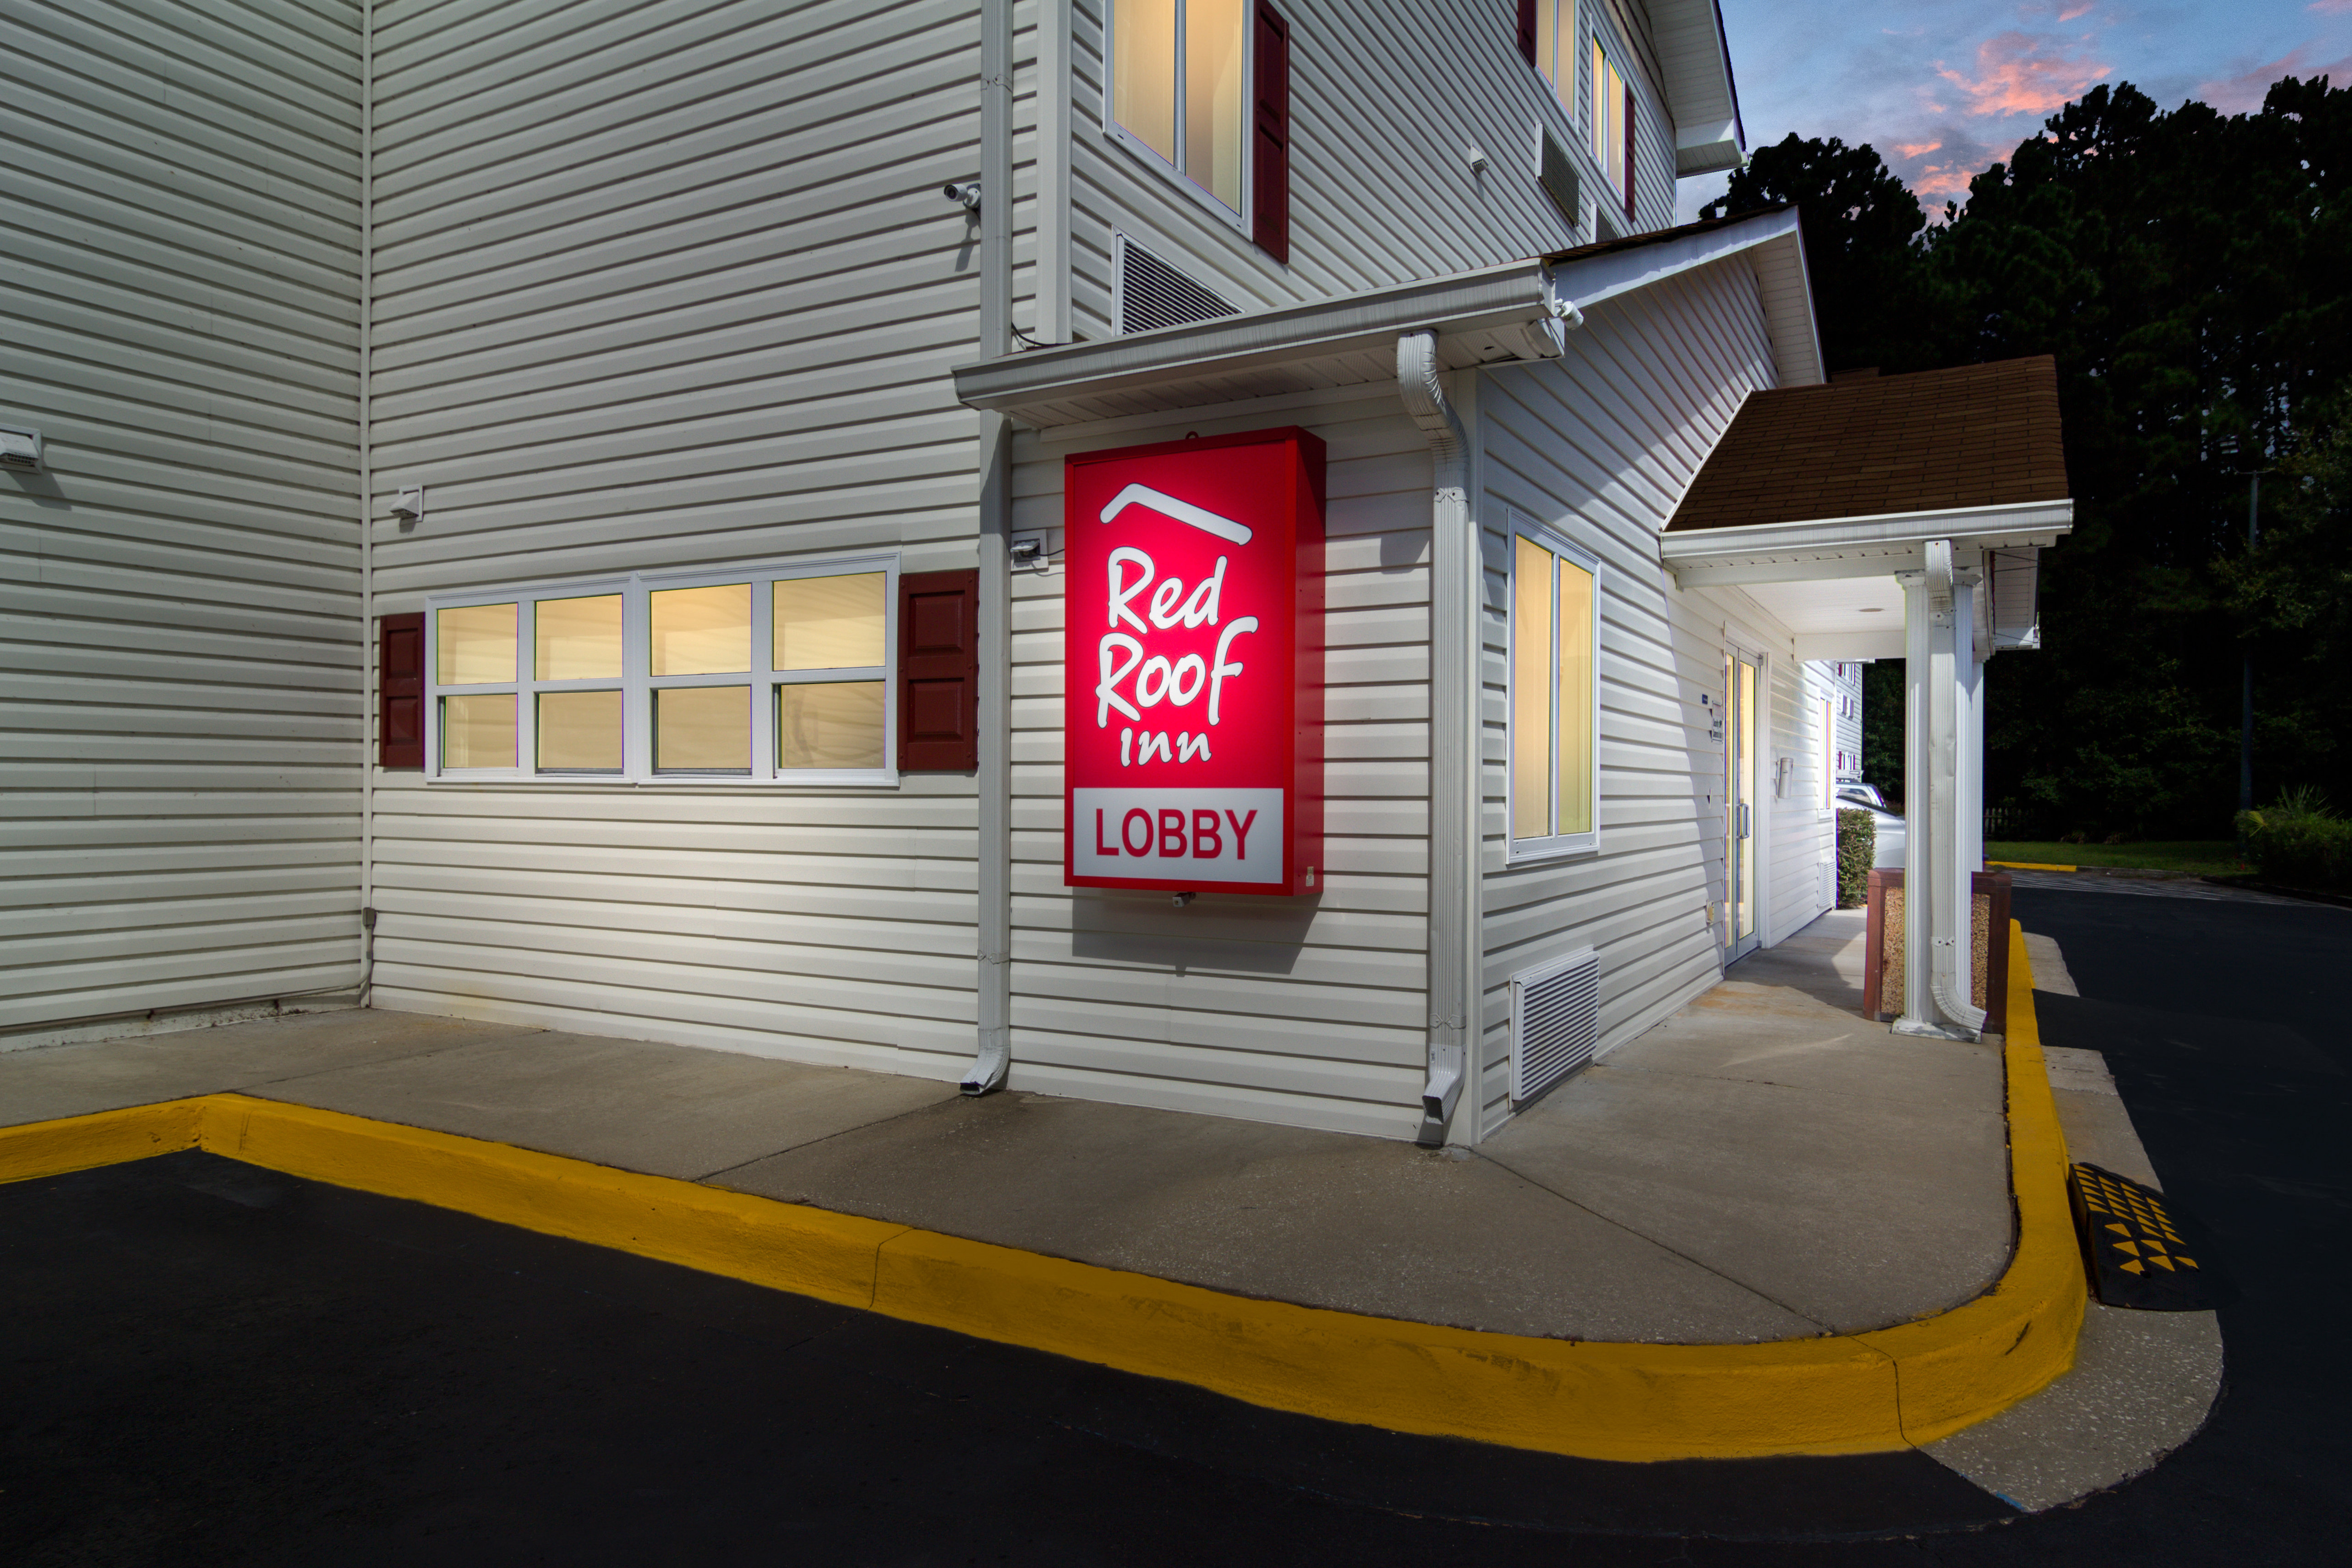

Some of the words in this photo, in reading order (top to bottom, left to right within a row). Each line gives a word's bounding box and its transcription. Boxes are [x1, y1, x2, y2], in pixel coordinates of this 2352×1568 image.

[1108, 547, 1227, 634] Red
[1096, 616, 1258, 728] Roof
[1097, 808, 1258, 859] LOBBY
